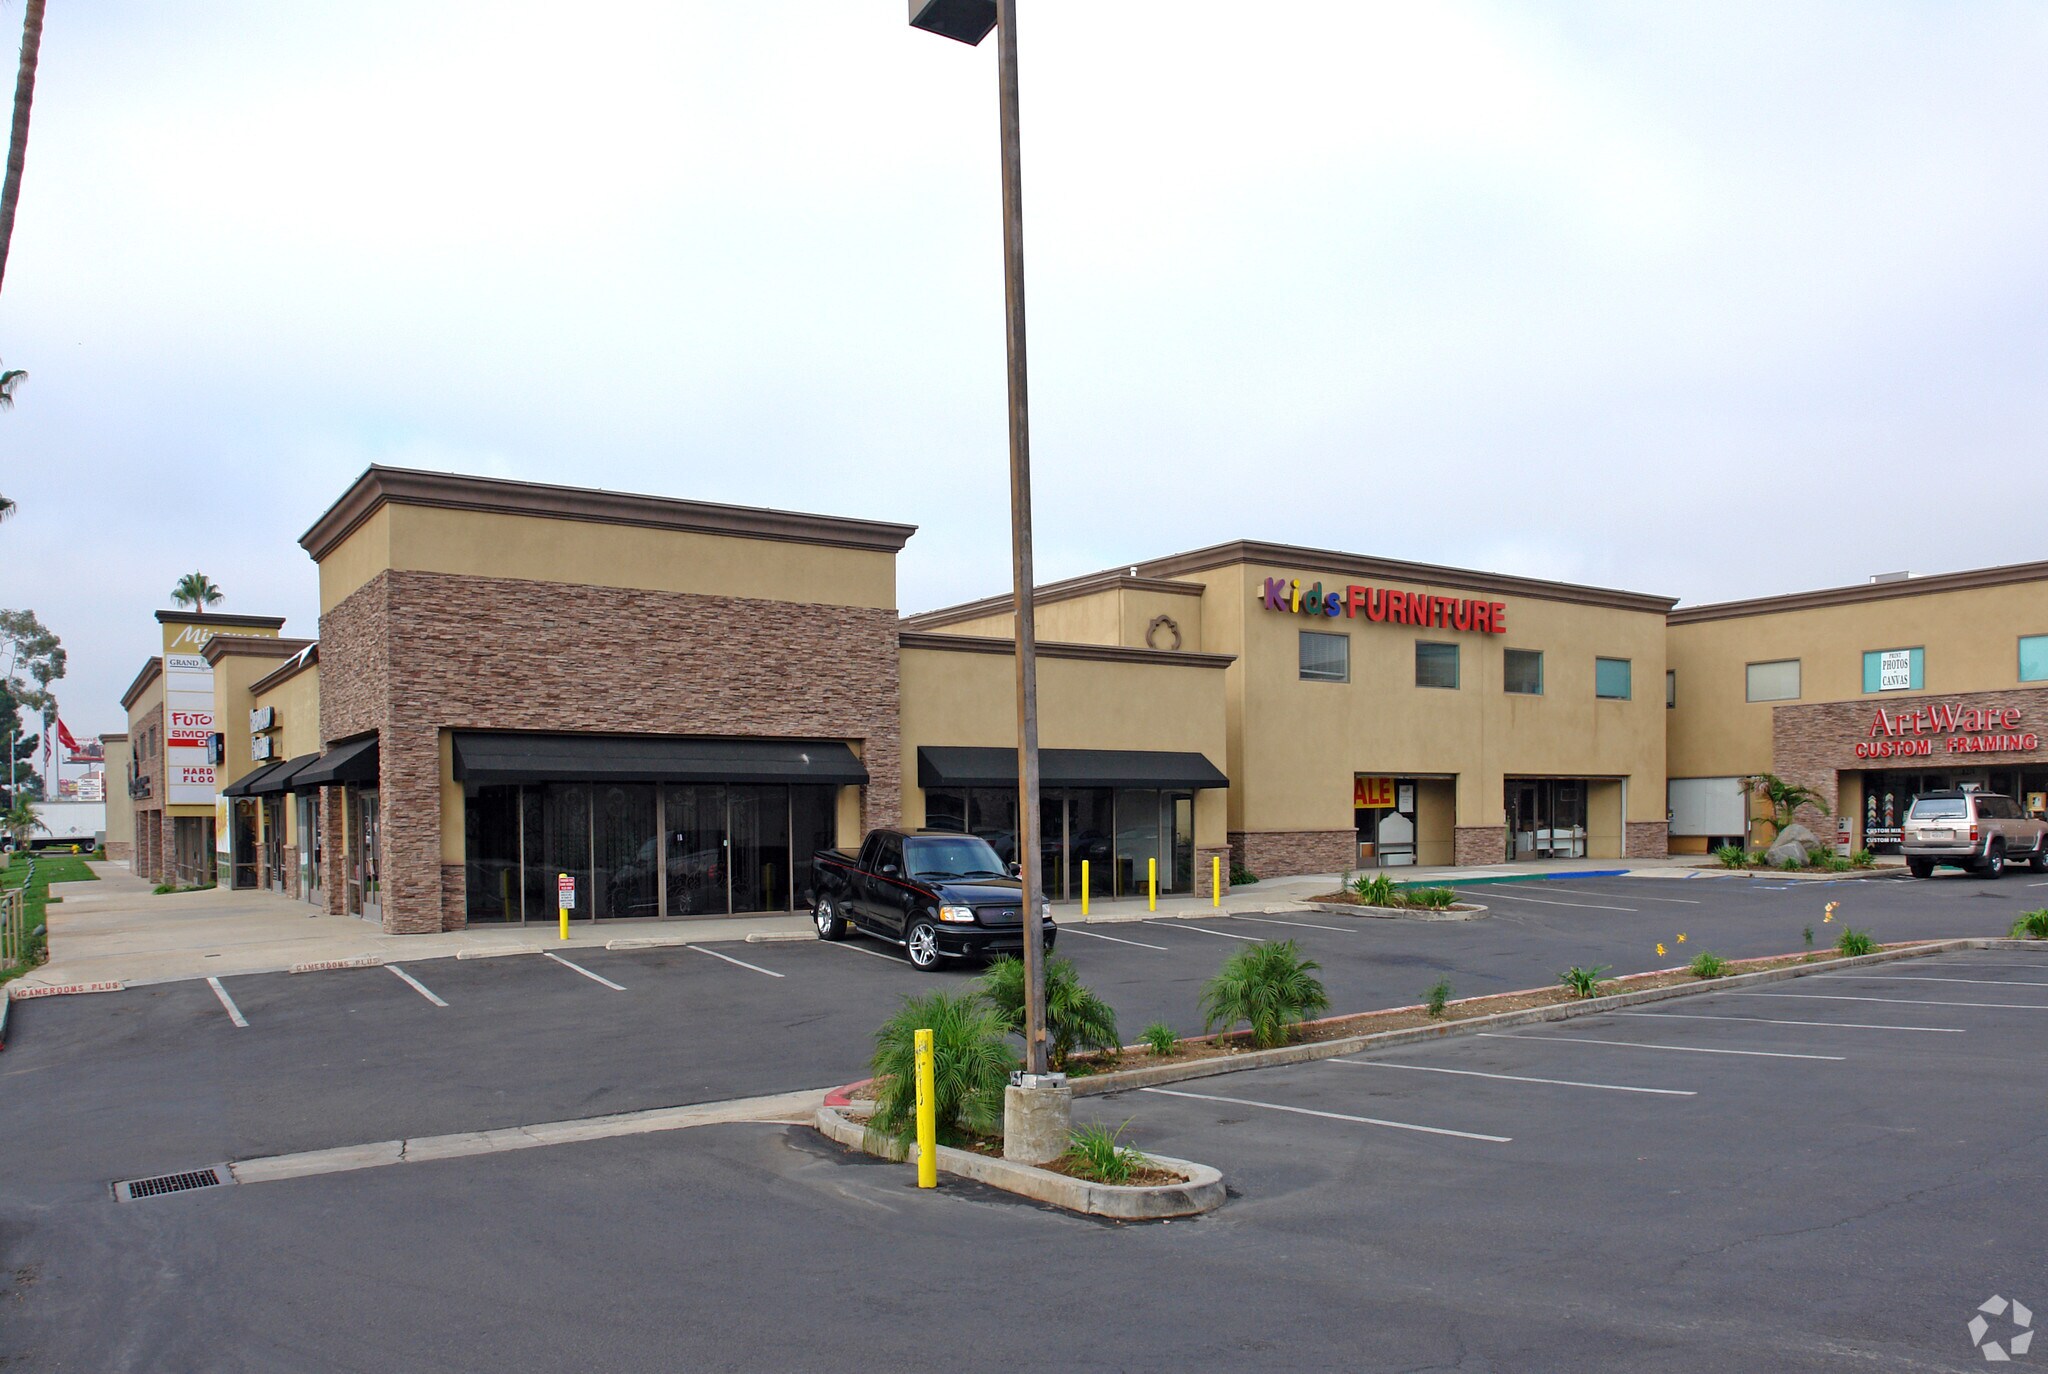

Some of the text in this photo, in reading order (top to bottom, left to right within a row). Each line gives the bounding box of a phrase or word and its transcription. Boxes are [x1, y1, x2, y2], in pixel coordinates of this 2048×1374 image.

[1264, 577, 1507, 634] Kids FURNITURE
[1882, 659, 1908, 670] PHOTOS
[1882, 675, 1908, 686] CANVAS
[172, 712, 214, 726] FUTO
[1869, 703, 2021, 737] ArtWare
[1855, 733, 2038, 759] CUSTOM FRAMING
[296, 961, 348, 972] GAMEROOMS
[21, 982, 118, 997] GAMEROOMS PLUS
